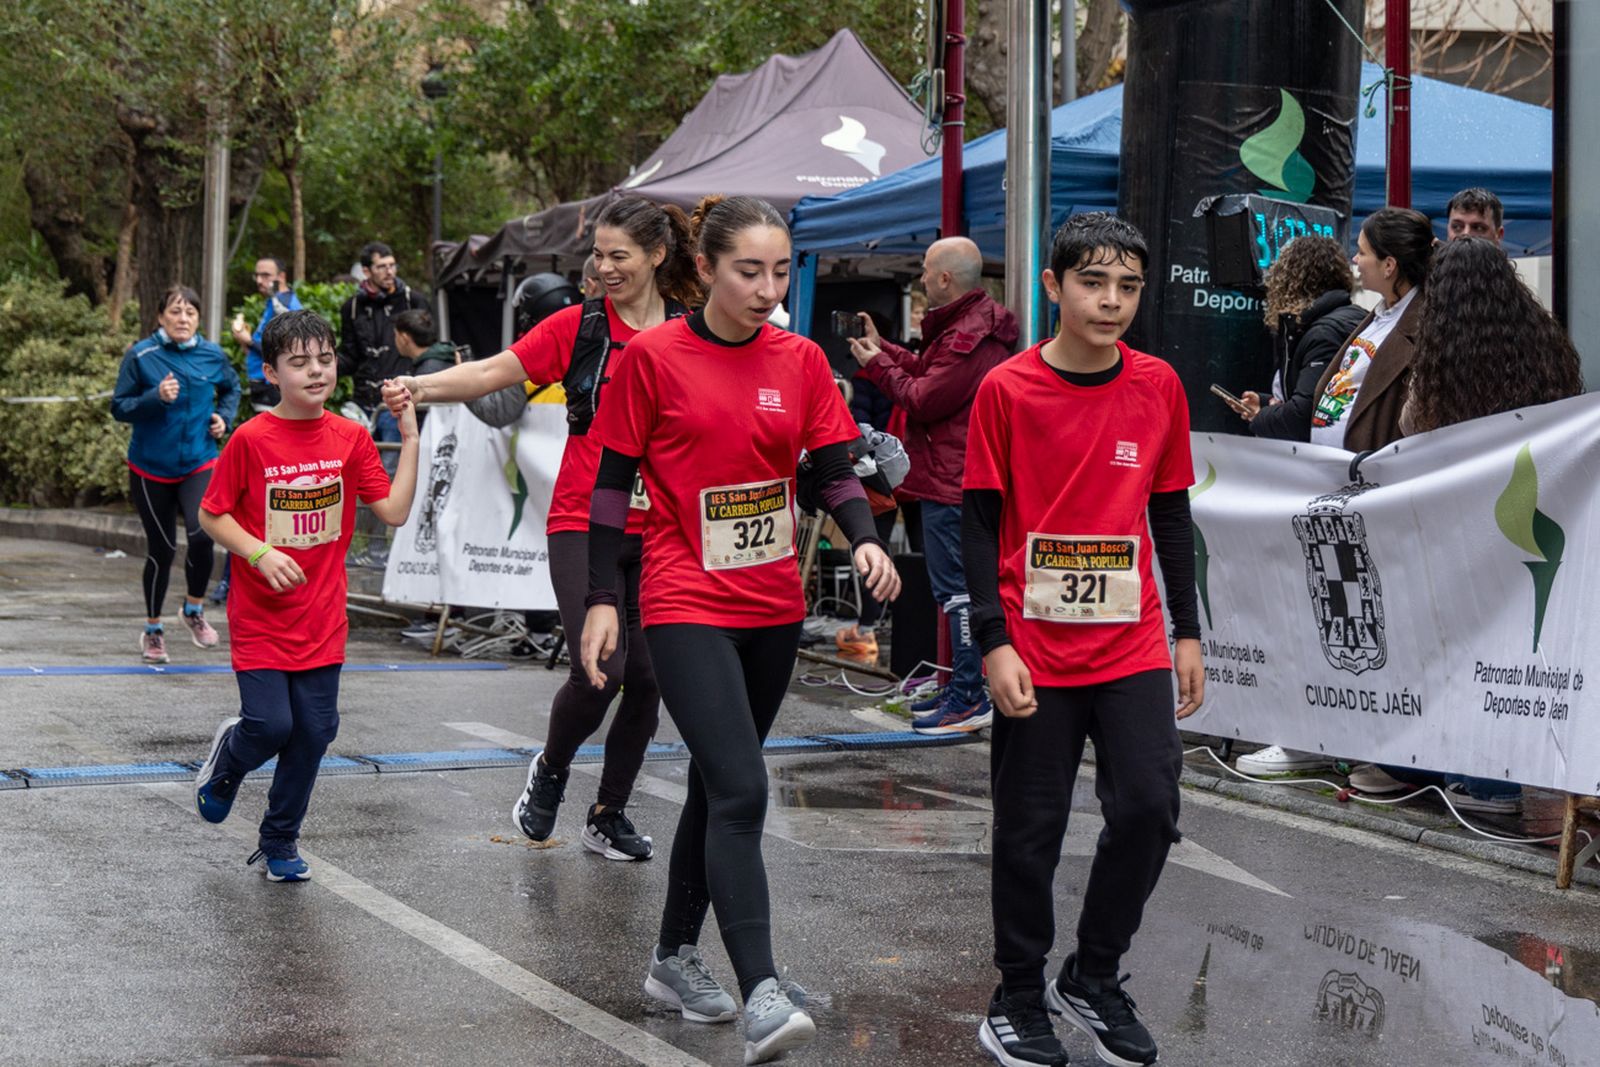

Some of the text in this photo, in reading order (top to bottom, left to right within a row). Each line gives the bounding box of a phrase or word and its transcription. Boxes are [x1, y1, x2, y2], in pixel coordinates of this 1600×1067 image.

[1170, 264, 1211, 284] Patr
[280, 465, 297, 475] San
[299, 463, 318, 472] Juan
[320, 460, 342, 470] Bosco
[272, 494, 339, 510] V CARRERA POPULAR
[275, 490, 286, 498] IES
[288, 491, 303, 499] San
[304, 490, 321, 499] Juan
[711, 493, 727, 505] IES
[728, 491, 747, 503] San
[709, 495, 785, 519] V CARRERA POPULAR
[292, 510, 326, 535] 1101
[733, 515, 776, 551] 322
[462, 542, 499, 557] Patronato
[500, 545, 537, 563] Municipal
[1039, 541, 1128, 554] IES San Juan Bosco
[468, 559, 502, 575] Deportes
[502, 562, 514, 575] de
[1035, 554, 1130, 569] V CARRERA POPULAR
[1060, 573, 1107, 604] 321
[1208, 640, 1252, 666] Municipal
[1252, 644, 1266, 664] de
[1222, 665, 1234, 684] de
[1236, 666, 1258, 688] Jaén
[1474, 660, 1584, 695] Patronato Municipal de
[1305, 684, 1422, 717] CIUDAD DE JAÉN
[1484, 690, 1531, 719] Deportes
[1533, 695, 1546, 718] de
